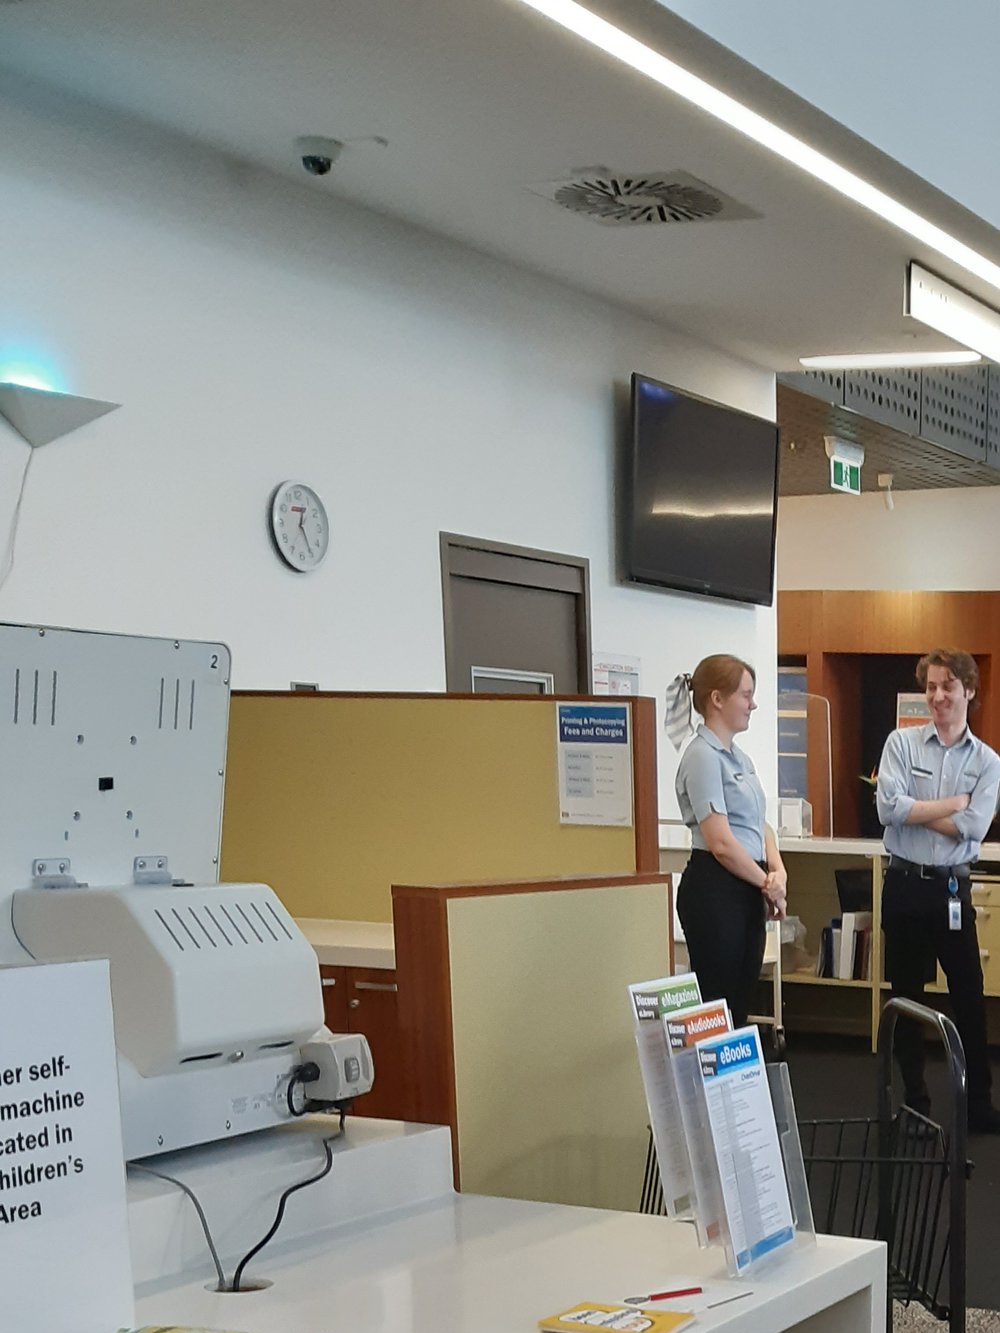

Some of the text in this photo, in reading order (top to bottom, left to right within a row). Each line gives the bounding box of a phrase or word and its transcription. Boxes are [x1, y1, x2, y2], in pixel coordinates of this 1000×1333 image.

[210, 655, 219, 669] 2
[564, 727, 624, 738] Fees and Charges
[661, 988, 699, 1007] eMagazines
[687, 1013, 726, 1036] eAudiobooks
[720, 1042, 752, 1065] eBooks
[0, 1055, 71, 1088] er self-
[0, 1090, 85, 1122] machine
[55, 1124, 73, 1145] in
